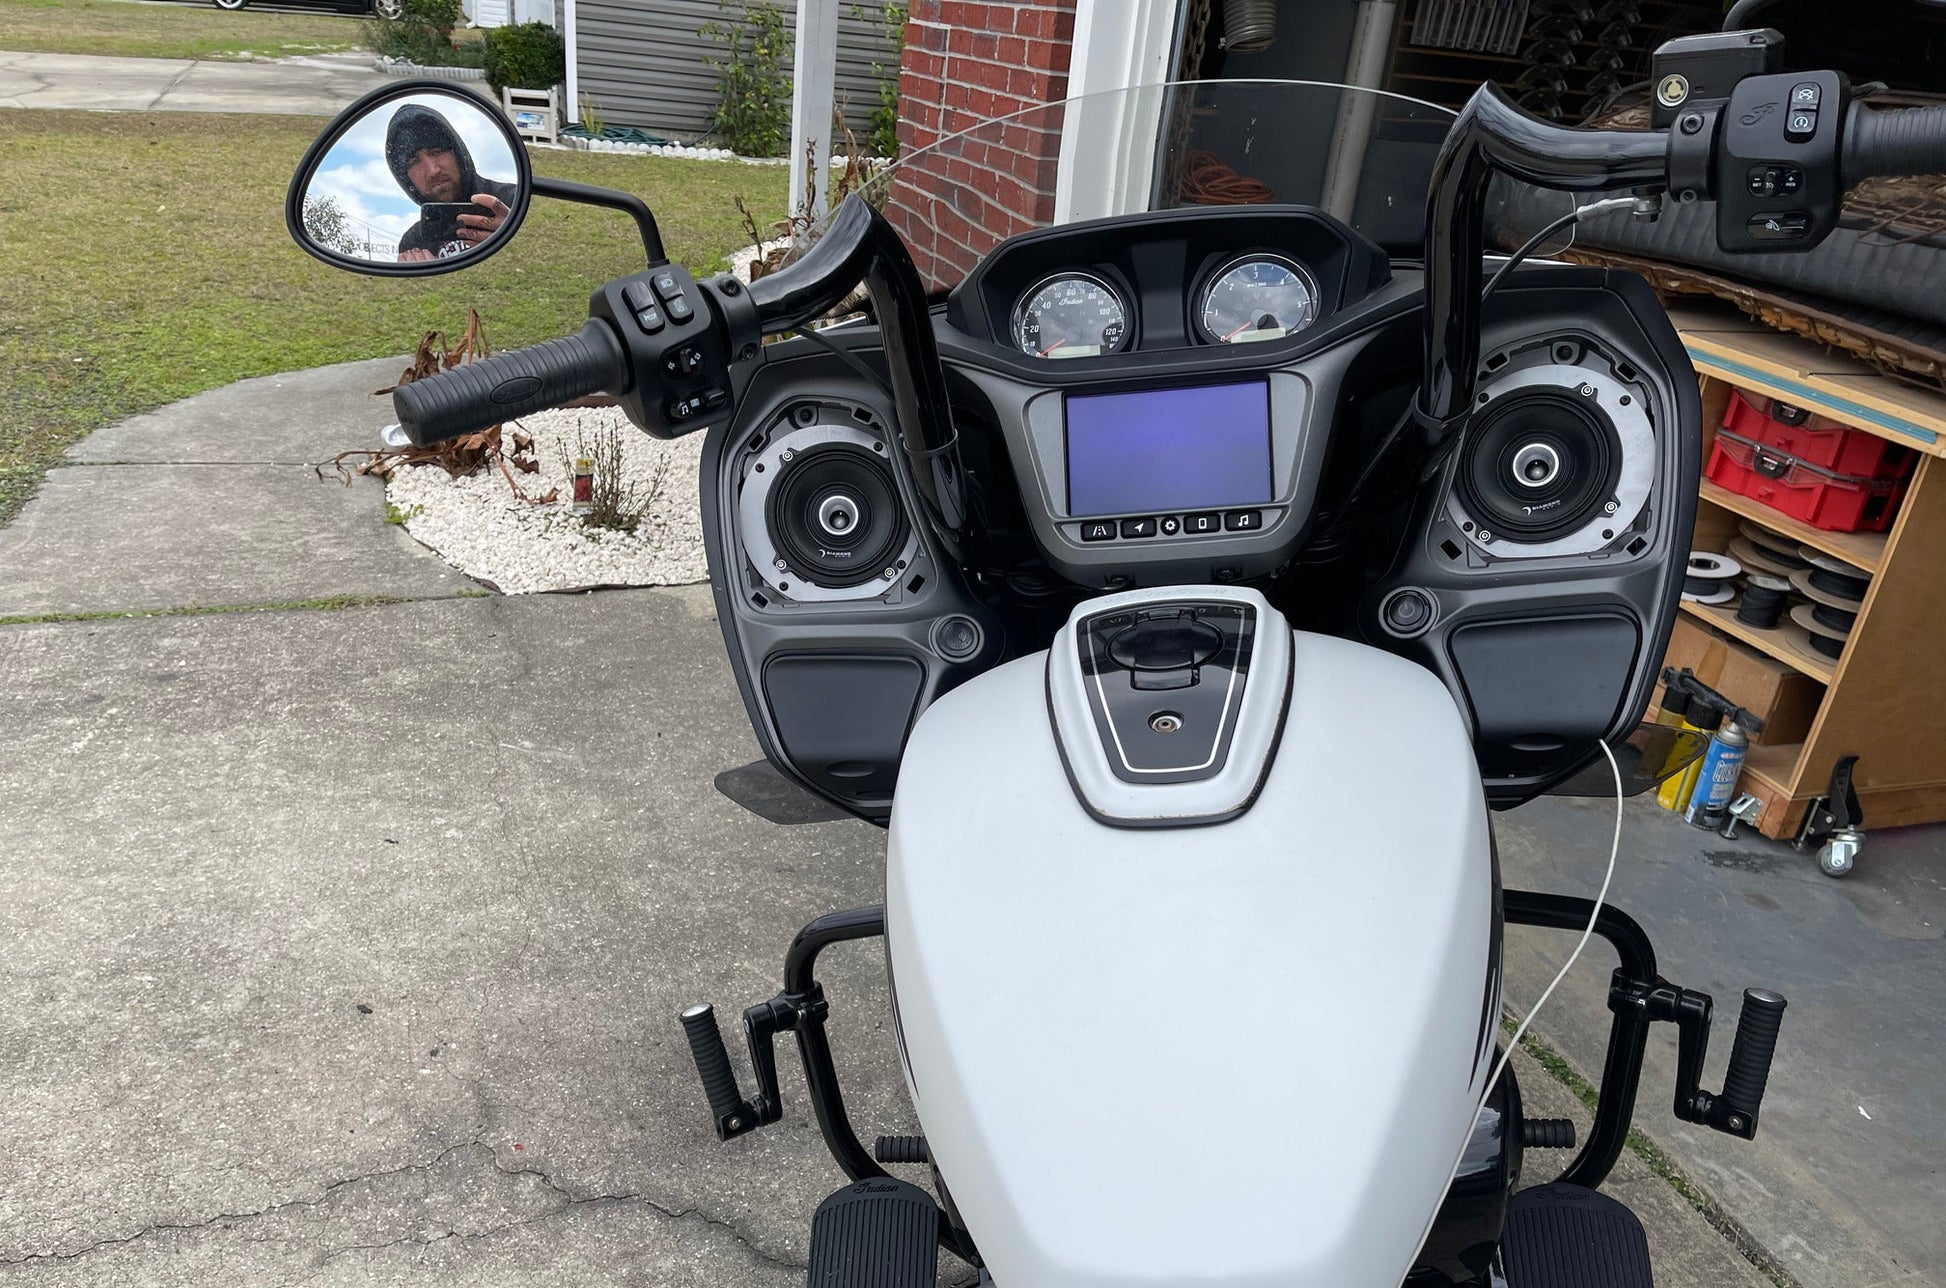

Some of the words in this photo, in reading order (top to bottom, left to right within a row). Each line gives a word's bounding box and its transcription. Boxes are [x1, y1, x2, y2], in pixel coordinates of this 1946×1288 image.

[1253, 271, 1259, 279] 3
[1279, 278, 1285, 286] 4
[1228, 283, 1234, 291] 2
[1066, 288, 1076, 296] 60
[1088, 292, 1097, 300] 80
[1041, 301, 1052, 310] 40
[1297, 300, 1302, 308] 5
[1099, 308, 1110, 316] 100
[1029, 325, 1040, 333] 20
[1105, 327, 1117, 336] 120
[853, 1182, 899, 1194] Indian
